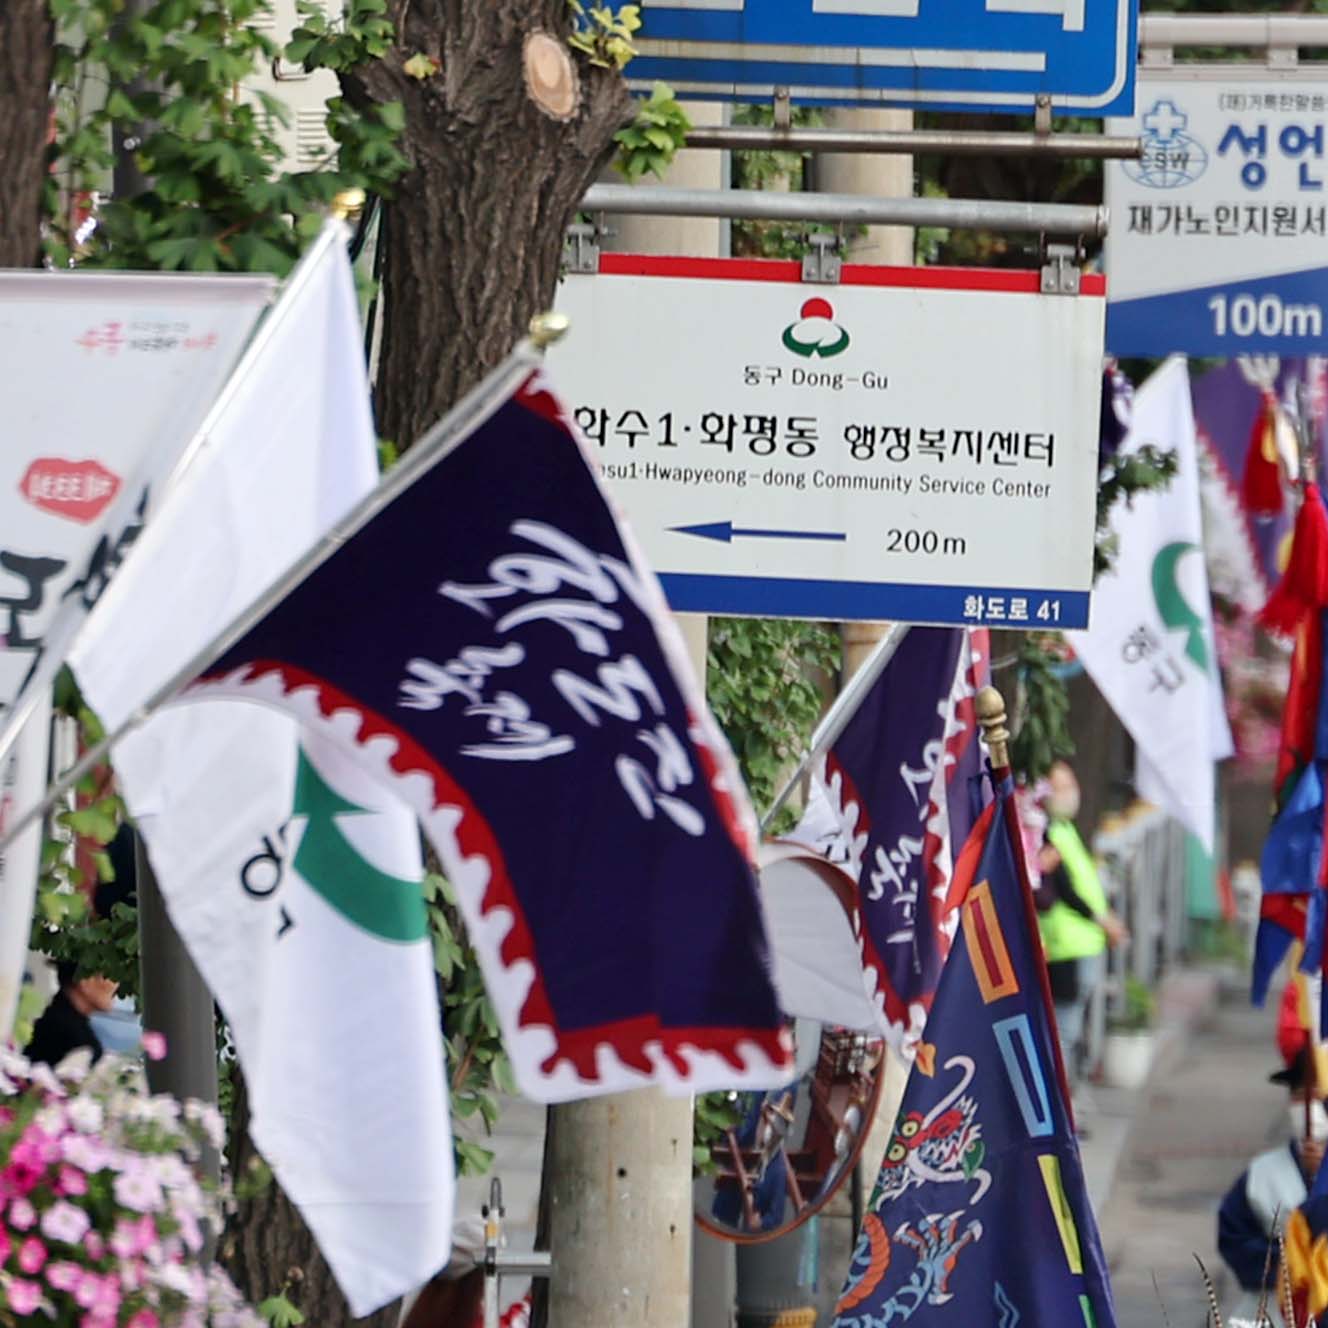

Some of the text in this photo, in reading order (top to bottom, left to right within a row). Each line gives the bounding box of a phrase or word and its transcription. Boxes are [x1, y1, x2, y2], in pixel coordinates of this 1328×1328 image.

[1208, 294, 1322, 337] 100m
[744, 365, 889, 391] 동구 Dong-Gu
[843, 423, 1055, 468] 행정복지센터
[600, 464, 1052, 498] su1·Hwapyeong-dong Community Service Center
[886, 529, 967, 555] 200m
[963, 595, 1061, 620] 화도로 41
